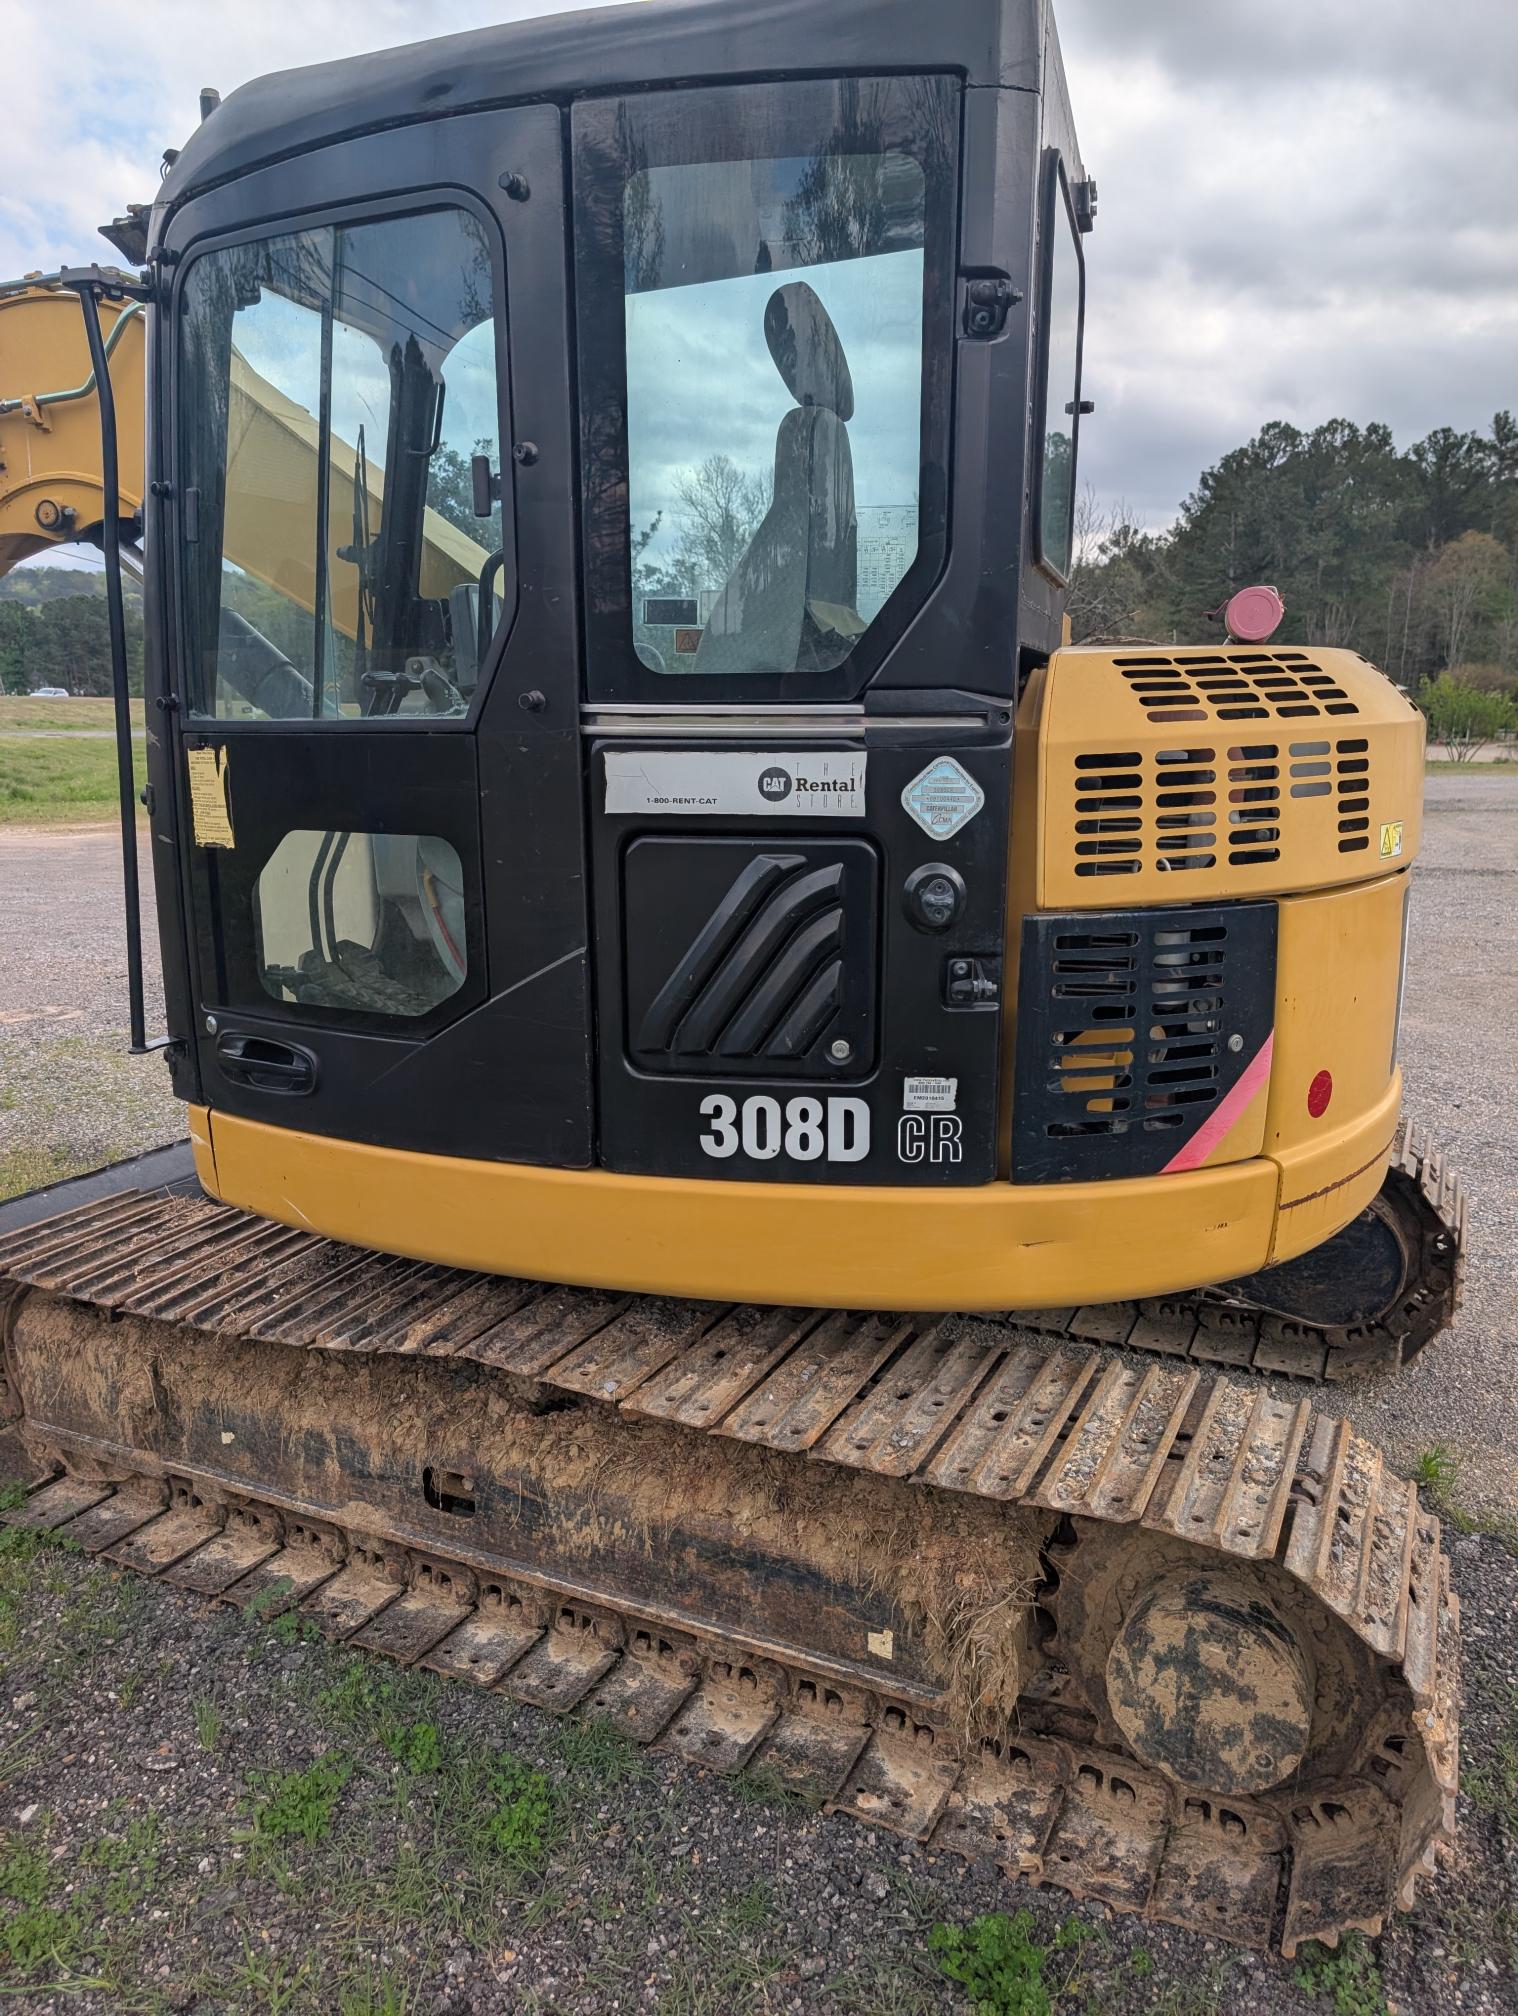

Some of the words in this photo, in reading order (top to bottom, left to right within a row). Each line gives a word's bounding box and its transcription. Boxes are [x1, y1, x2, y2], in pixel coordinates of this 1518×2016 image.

[796, 761, 856, 777] THE
[762, 777, 787, 792] CAT
[795, 777, 856, 792] Rental
[646, 797, 718, 805] 1-800-RENT-CAT
[699, 1093, 871, 1162] 308D
[897, 1114, 963, 1163] CR
